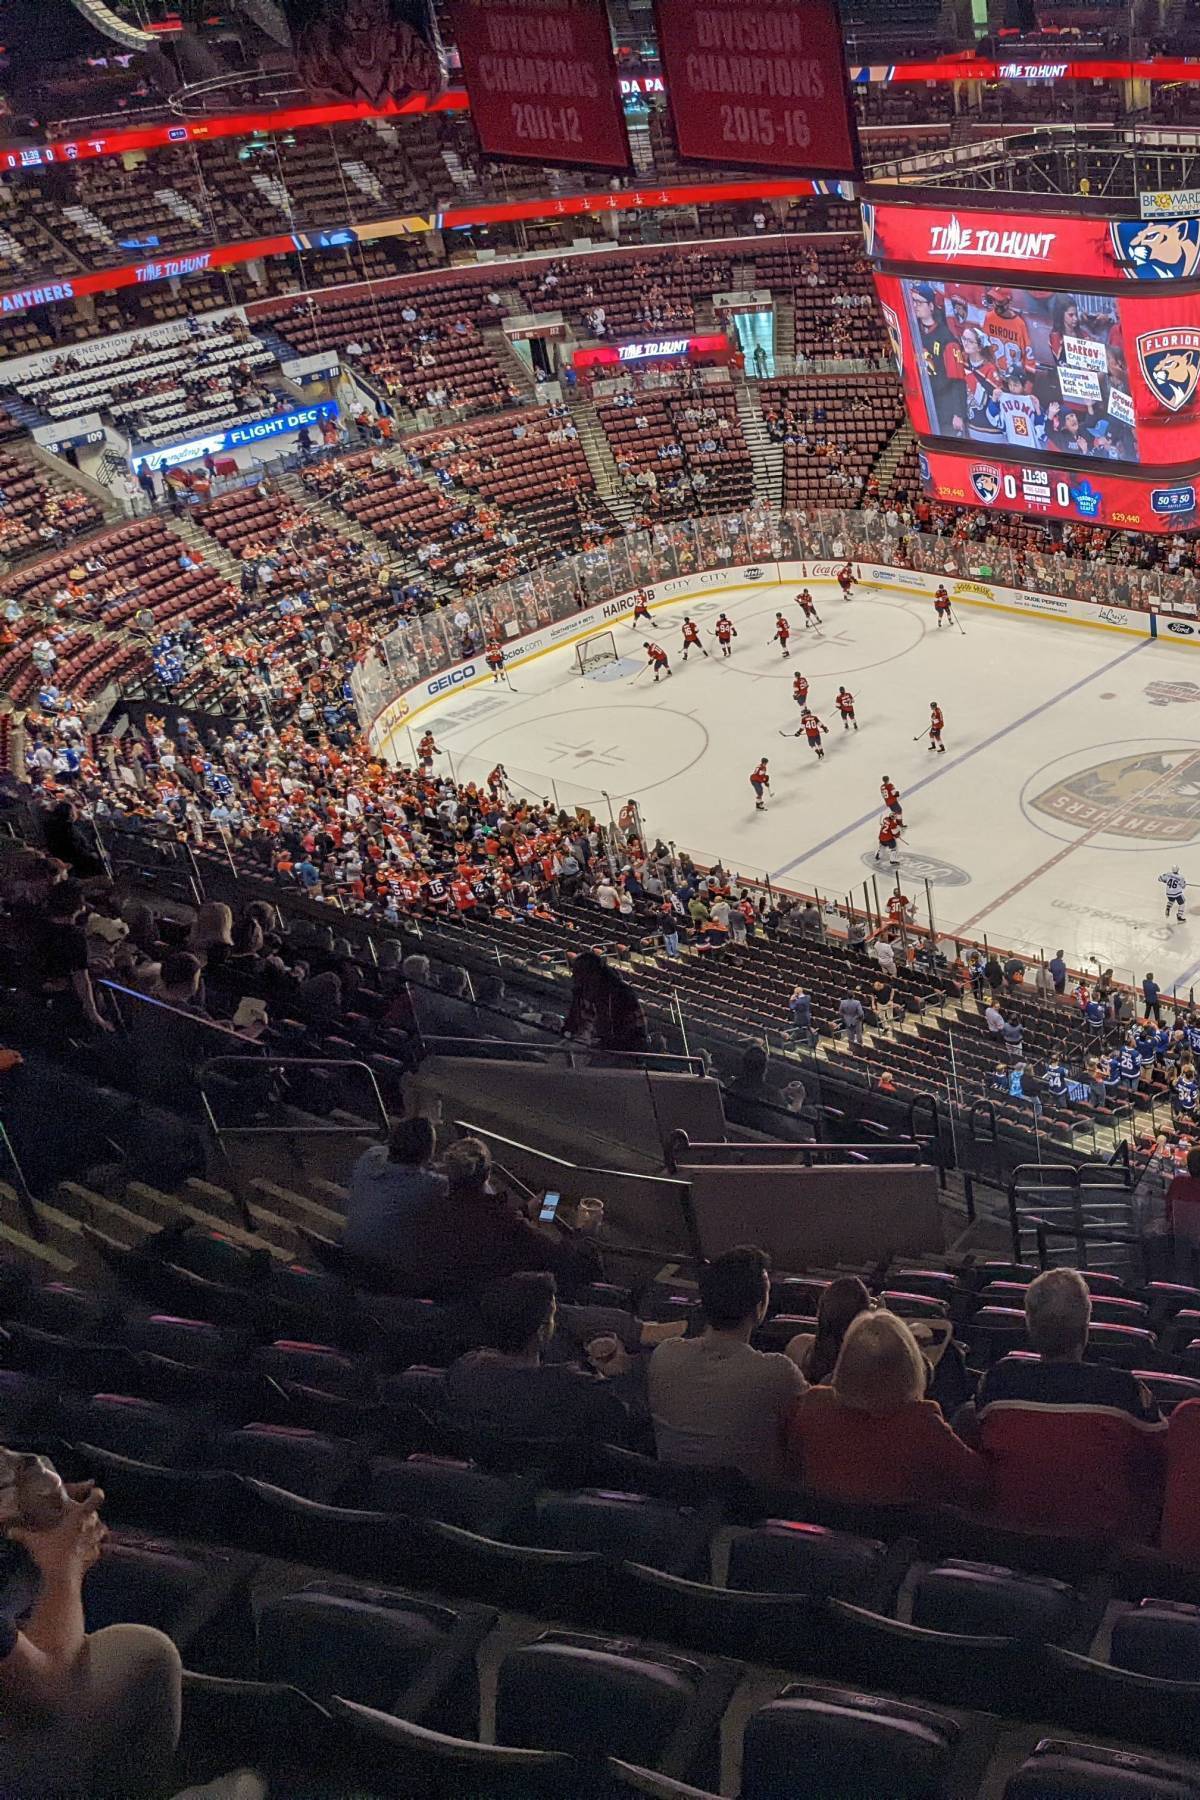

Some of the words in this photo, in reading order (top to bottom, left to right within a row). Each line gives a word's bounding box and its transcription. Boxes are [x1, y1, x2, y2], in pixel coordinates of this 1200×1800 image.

[696, 10, 801, 49] DIVISION
[478, 56, 598, 98] CHAMPIONS
[687, 55, 824, 98] CHAMPIONS
[1000, 64, 1022, 77] TIME
[1024, 66, 1038, 77] TO
[1038, 65, 1068, 77] HUNT
[511, 103, 583, 143] 2011-12
[720, 104, 811, 148] 2015-16
[931, 214, 973, 261] TIME
[976, 230, 998, 253] TO
[1000, 231, 1056, 257] HUNT
[135, 264, 162, 282] TIME
[164, 262, 180, 277] TO
[180, 254, 211, 273] HUNT
[0, 283, 74, 312] ANTHERS
[70, 338, 128, 357] GENERATION
[130, 332, 142, 344] OF
[144, 328, 170, 341] LIGHT
[659, 340, 690, 353] HUNT
[1066, 342, 1098, 358] BARKOV
[1146, 334, 1200, 351] FLORIDA
[86, 432, 102, 444] 109
[231, 420, 286, 443] FLIGHT
[1004, 475, 1017, 499] 0
[1022, 468, 1048, 485] 11:39
[1056, 482, 1070, 506] 0
[1158, 496, 1170, 505] 50
[1179, 494, 1190, 503] 50
[1112, 513, 1140, 524] $29,440
[664, 578, 690, 592] CITY
[701, 572, 729, 583] CITY
[1170, 622, 1190, 634] Ford
[502, 638, 543, 662] ocios.com
[427, 664, 476, 696] GEICO
[1052, 796, 1185, 834] PANTHERS
[430, 883, 444, 896] 16
[1167, 878, 1178, 888] 46
[1120, 1056, 1134, 1070] 26
